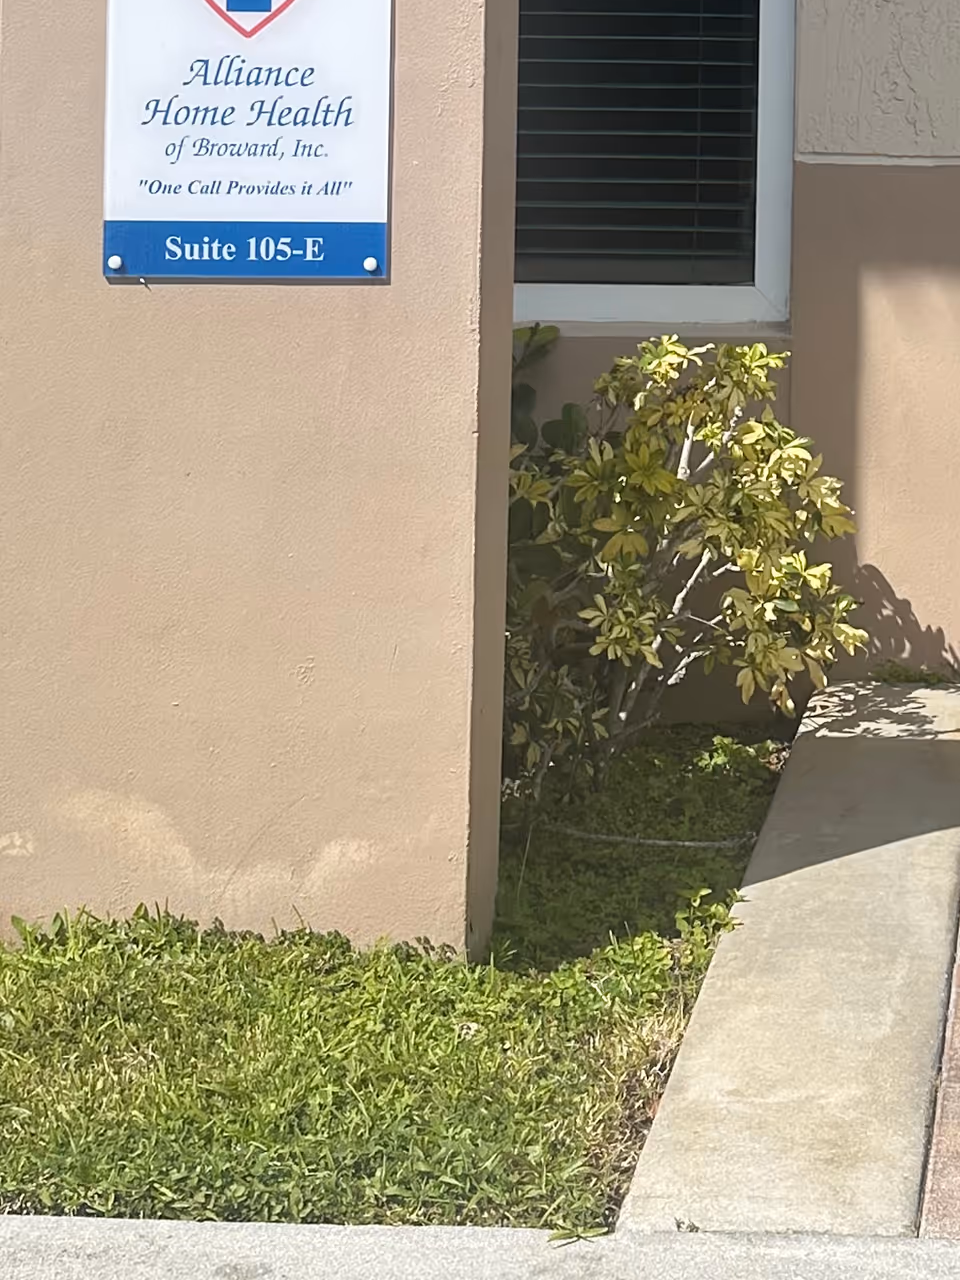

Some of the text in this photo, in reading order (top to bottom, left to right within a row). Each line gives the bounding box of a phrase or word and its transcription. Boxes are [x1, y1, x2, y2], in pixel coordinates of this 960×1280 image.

[182, 54, 315, 87] Alliance
[141, 94, 354, 127] Home Health
[164, 135, 329, 164] of Broward, Inc.
[138, 179, 353, 197] "One Call Provides it All"
[164, 236, 325, 261] Suite 105-E
